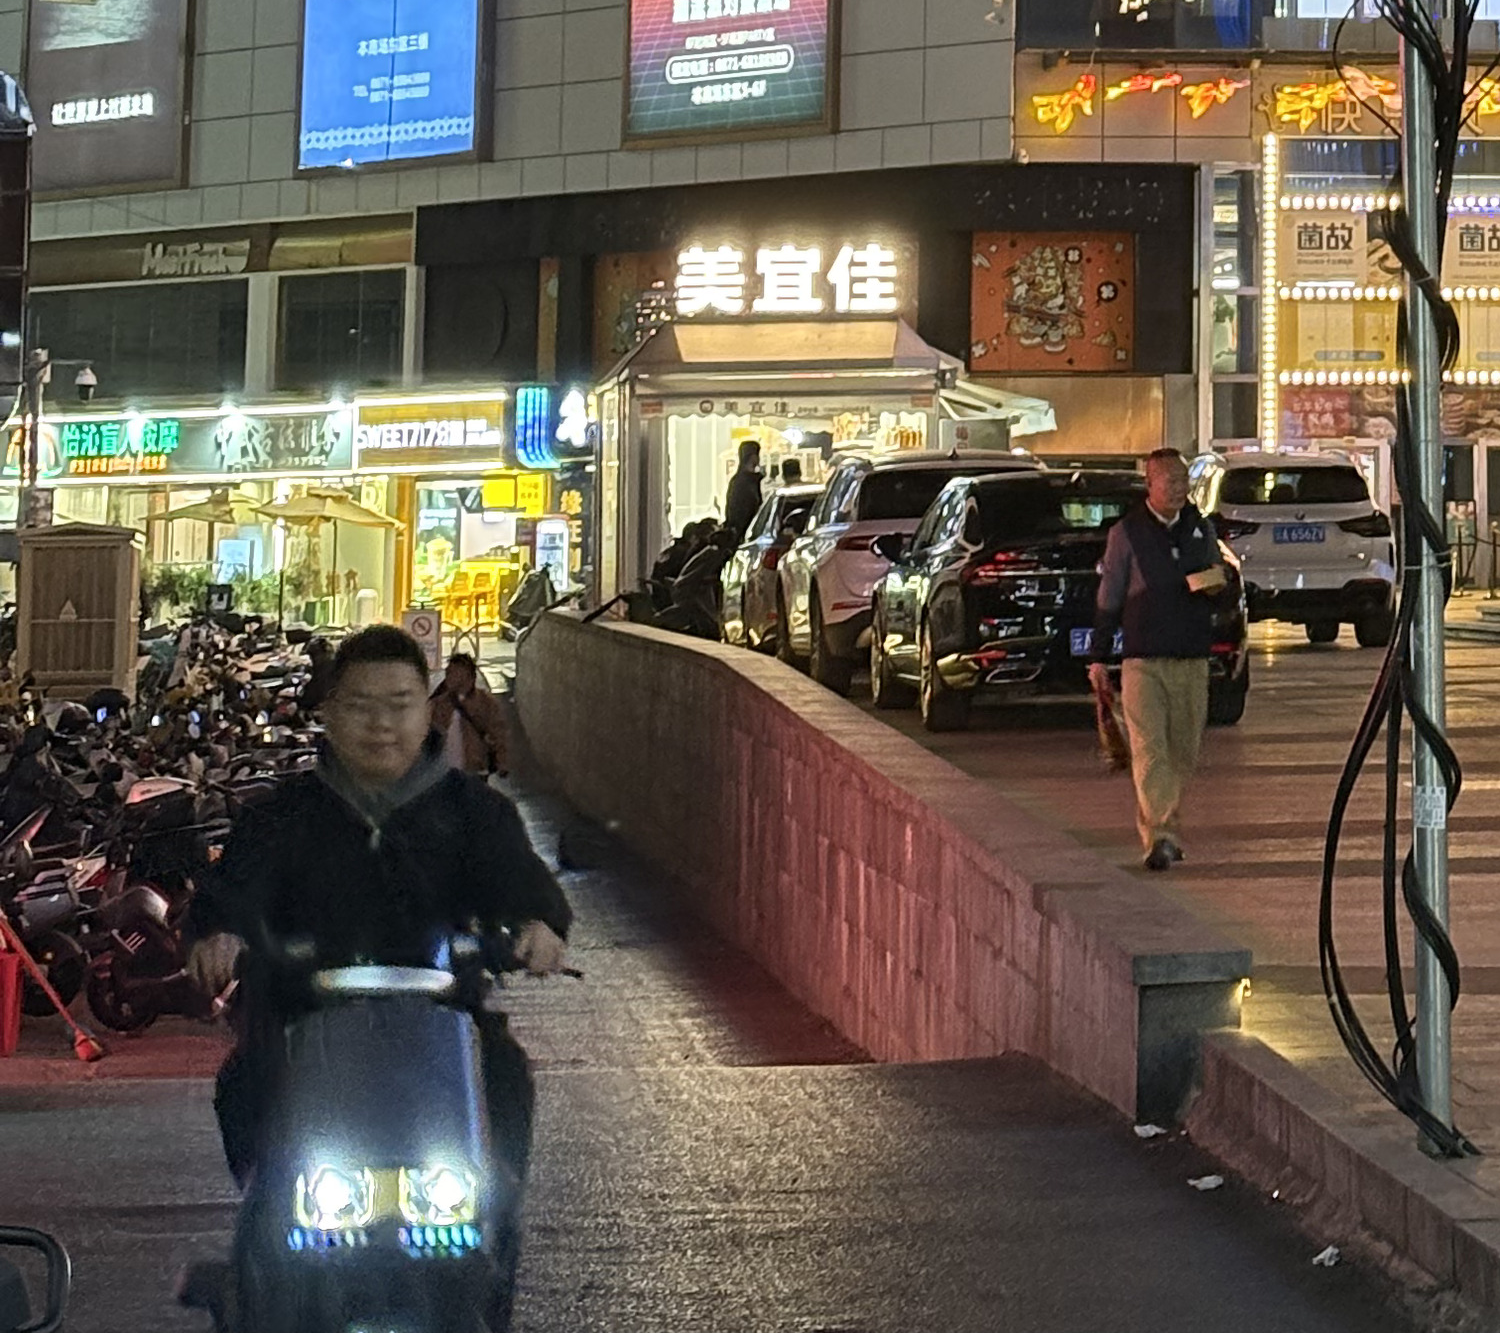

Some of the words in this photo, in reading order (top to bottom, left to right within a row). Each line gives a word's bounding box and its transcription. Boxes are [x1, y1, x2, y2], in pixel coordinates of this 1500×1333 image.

[1297, 222, 1354, 252] 菌故
[675, 241, 898, 315] 美宜佳
